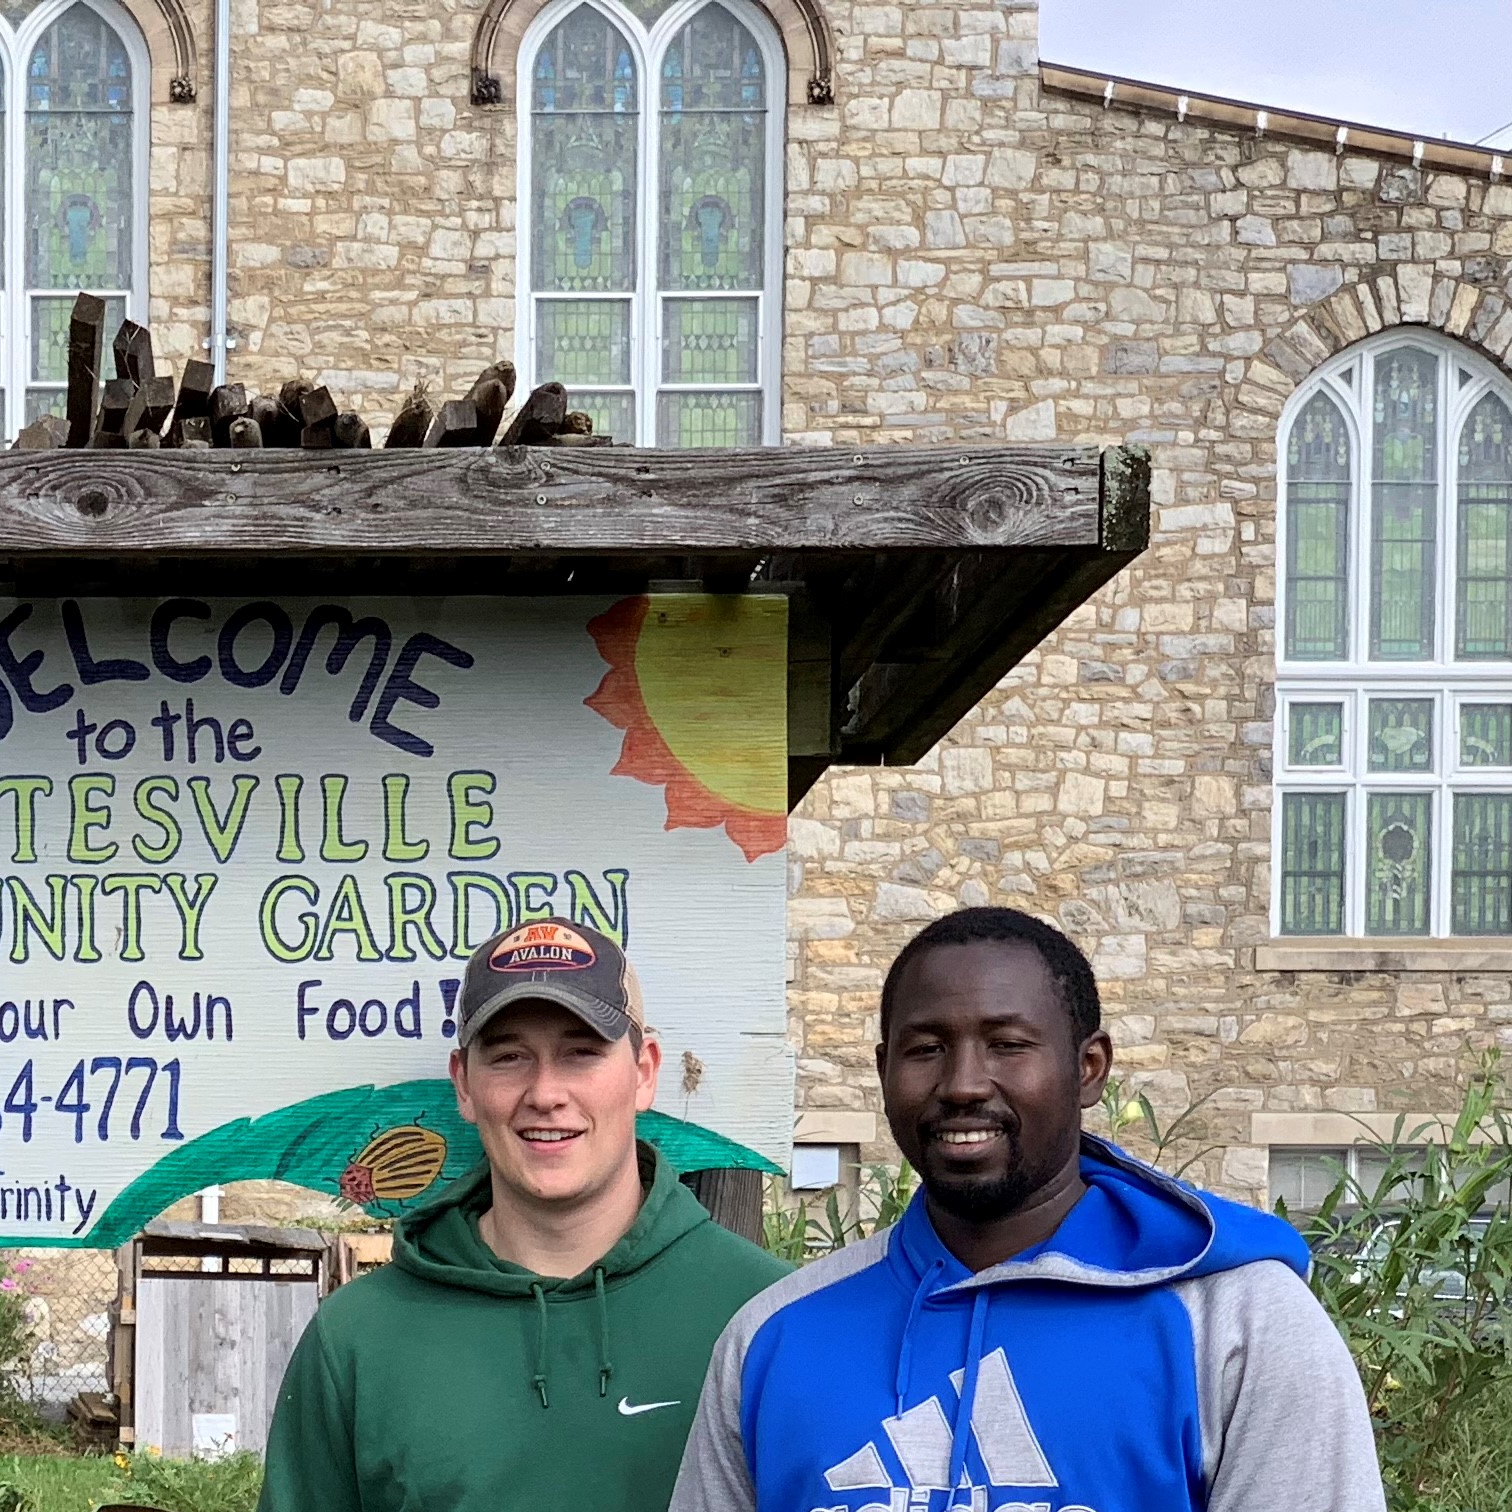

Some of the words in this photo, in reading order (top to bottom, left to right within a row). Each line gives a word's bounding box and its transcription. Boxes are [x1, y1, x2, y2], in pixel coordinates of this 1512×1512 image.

[66, 708, 136, 766] to
[150, 697, 262, 765] the
[508, 945, 573, 964] AVALON
[127, 979, 233, 1042] Own
